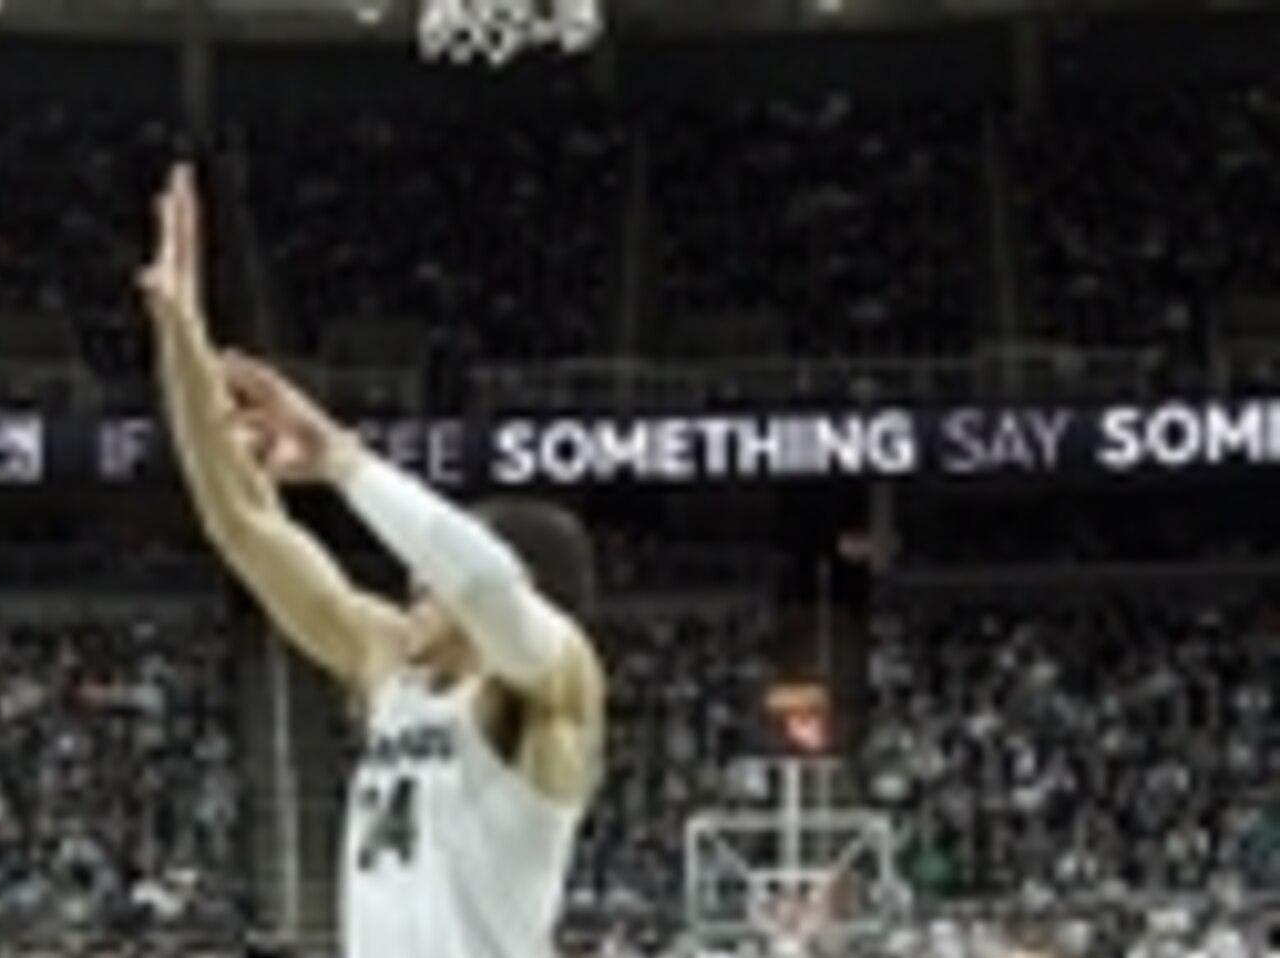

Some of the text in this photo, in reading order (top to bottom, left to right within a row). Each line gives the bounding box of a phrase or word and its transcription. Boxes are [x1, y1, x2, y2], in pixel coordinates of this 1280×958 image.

[99, 418, 152, 478] IF
[493, 409, 914, 484] SOMETHING
[943, 409, 1073, 474] SAY
